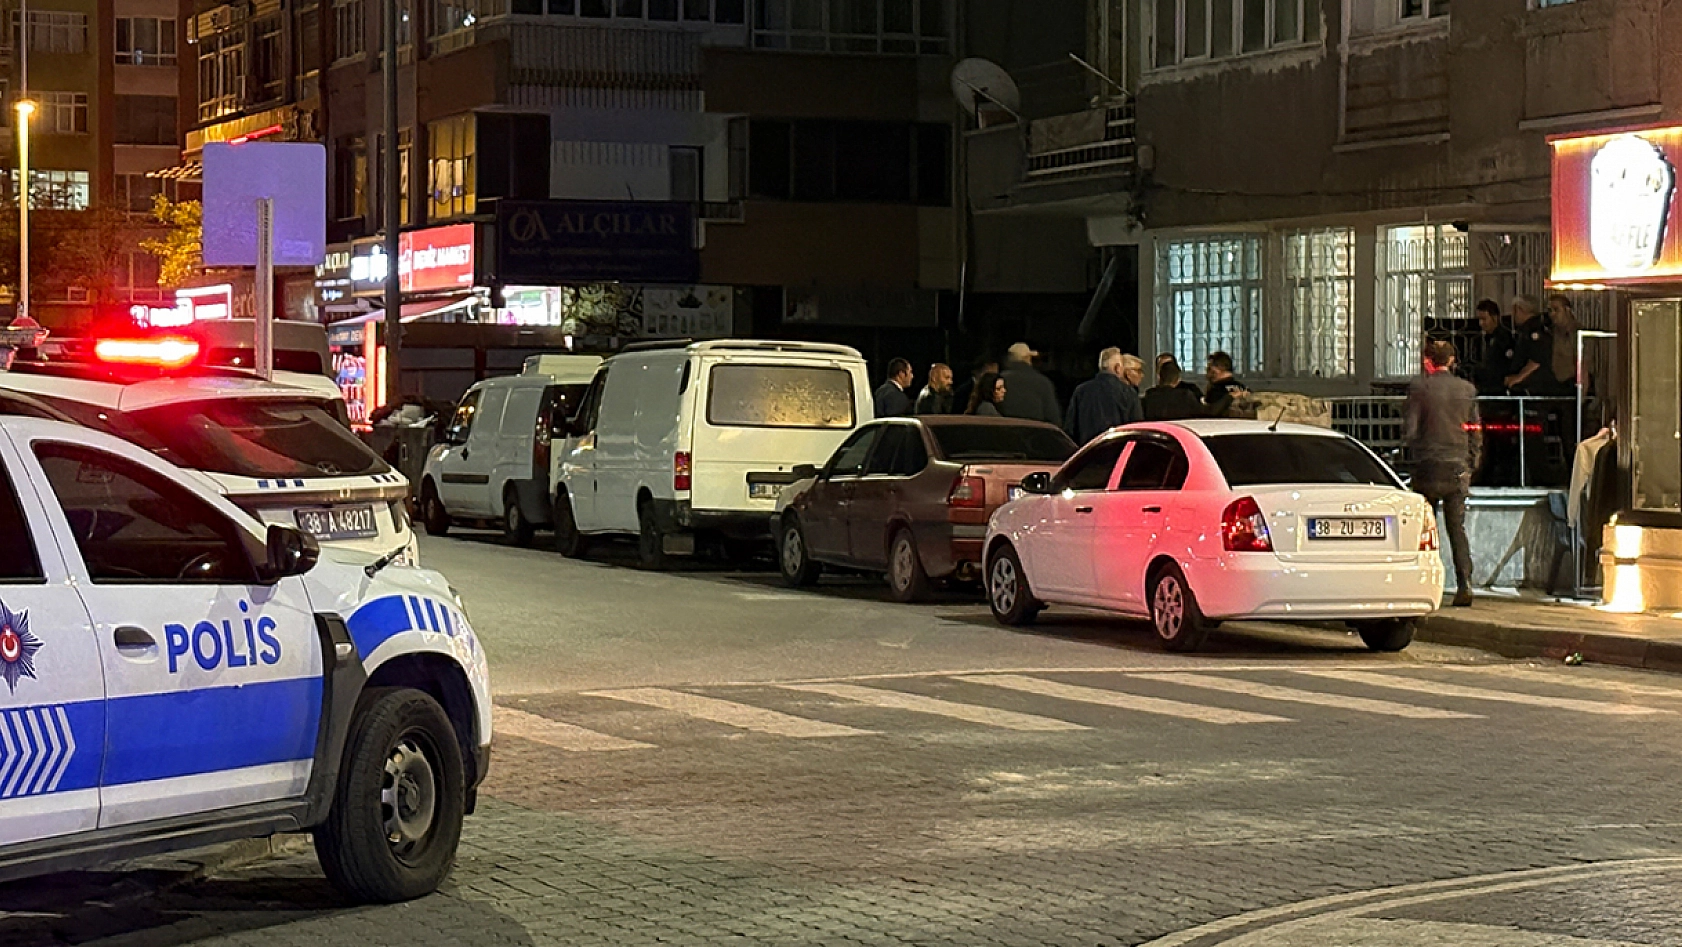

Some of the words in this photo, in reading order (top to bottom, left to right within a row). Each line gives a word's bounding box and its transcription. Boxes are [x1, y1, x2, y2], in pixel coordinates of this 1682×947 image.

[556, 212, 678, 238] ALÇILAR
[305, 511, 322, 533] 38
[328, 511, 338, 532] A
[339, 508, 370, 531] 48217
[1317, 521, 1330, 535] 38
[1340, 521, 1354, 535] ZU
[1362, 521, 1382, 535] 378
[164, 600, 281, 673] POLİS
